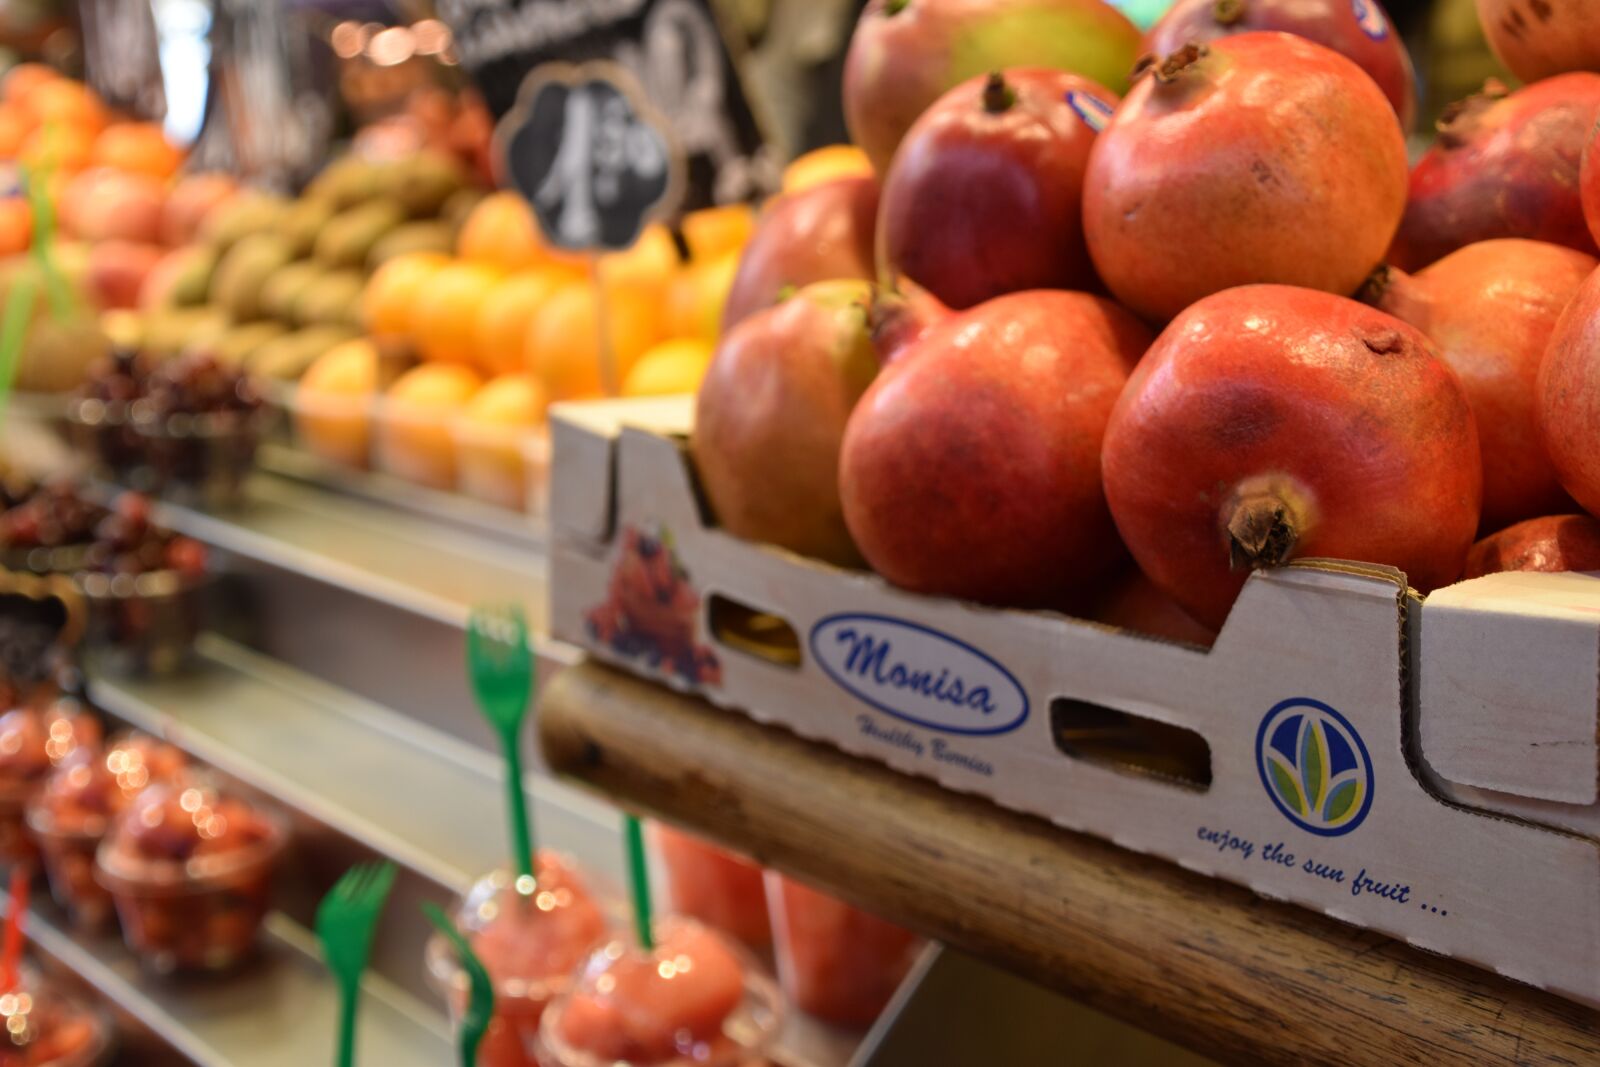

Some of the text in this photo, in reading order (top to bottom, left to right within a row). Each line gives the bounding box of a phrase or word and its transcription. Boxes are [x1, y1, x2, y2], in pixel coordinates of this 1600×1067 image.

[837, 630, 995, 714] Monisa
[1197, 827, 1254, 858] enjoy
[1262, 842, 1296, 868] the
[1303, 858, 1345, 883] sun
[1352, 869, 1411, 904] fruit
